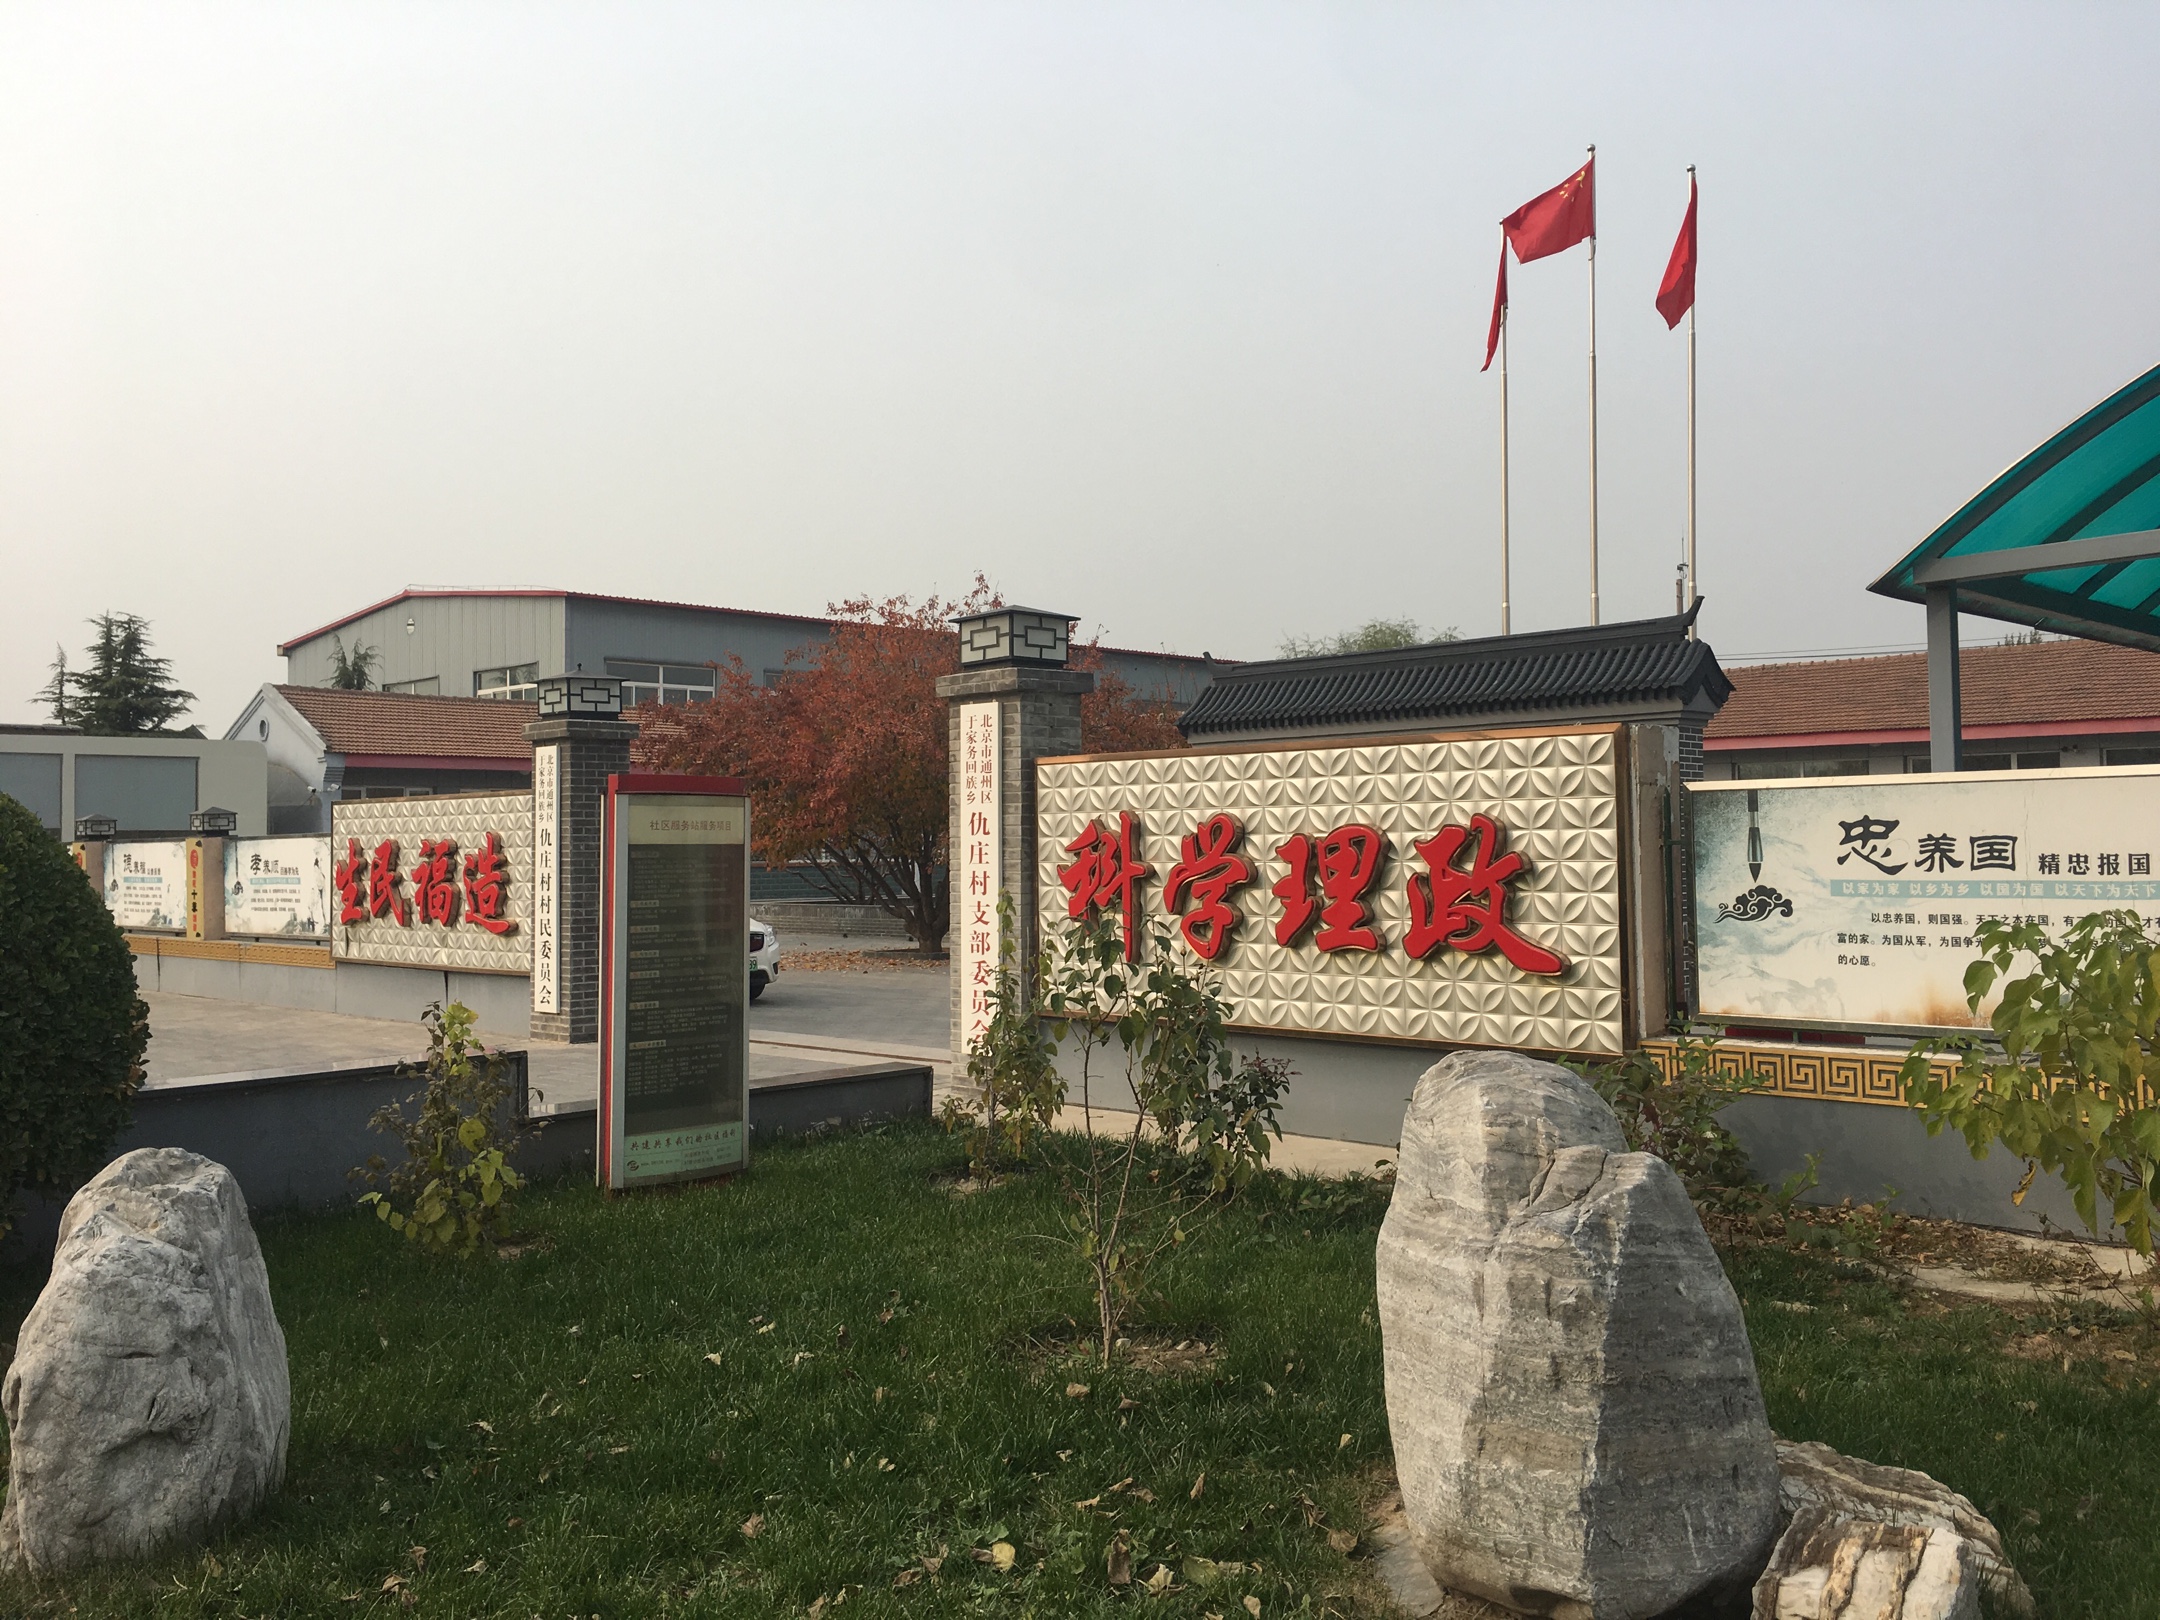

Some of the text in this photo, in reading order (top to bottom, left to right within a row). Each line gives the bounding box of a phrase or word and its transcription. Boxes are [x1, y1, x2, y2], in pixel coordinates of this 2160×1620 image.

[538, 755, 546, 823] 于家务回族乡
[546, 755, 554, 822] 北京市通州区
[966, 715, 977, 805] 于家务回族乡
[980, 714, 992, 803] 北京市通州区
[650, 820, 732, 831] 社区服务站服务项目
[1837, 815, 2151, 876] 忠养国 精忠报国
[539, 828, 552, 1004] 仇庄村村民委员会
[1057, 811, 1570, 974] 科学理政
[1842, 882, 2157, 898] 以家为家 以乡为乡 以国为国 以天下为天下
[968, 812, 991, 1046] 仇庄村支部委员会
[1838, 954, 1876, 967] 的心愿。
